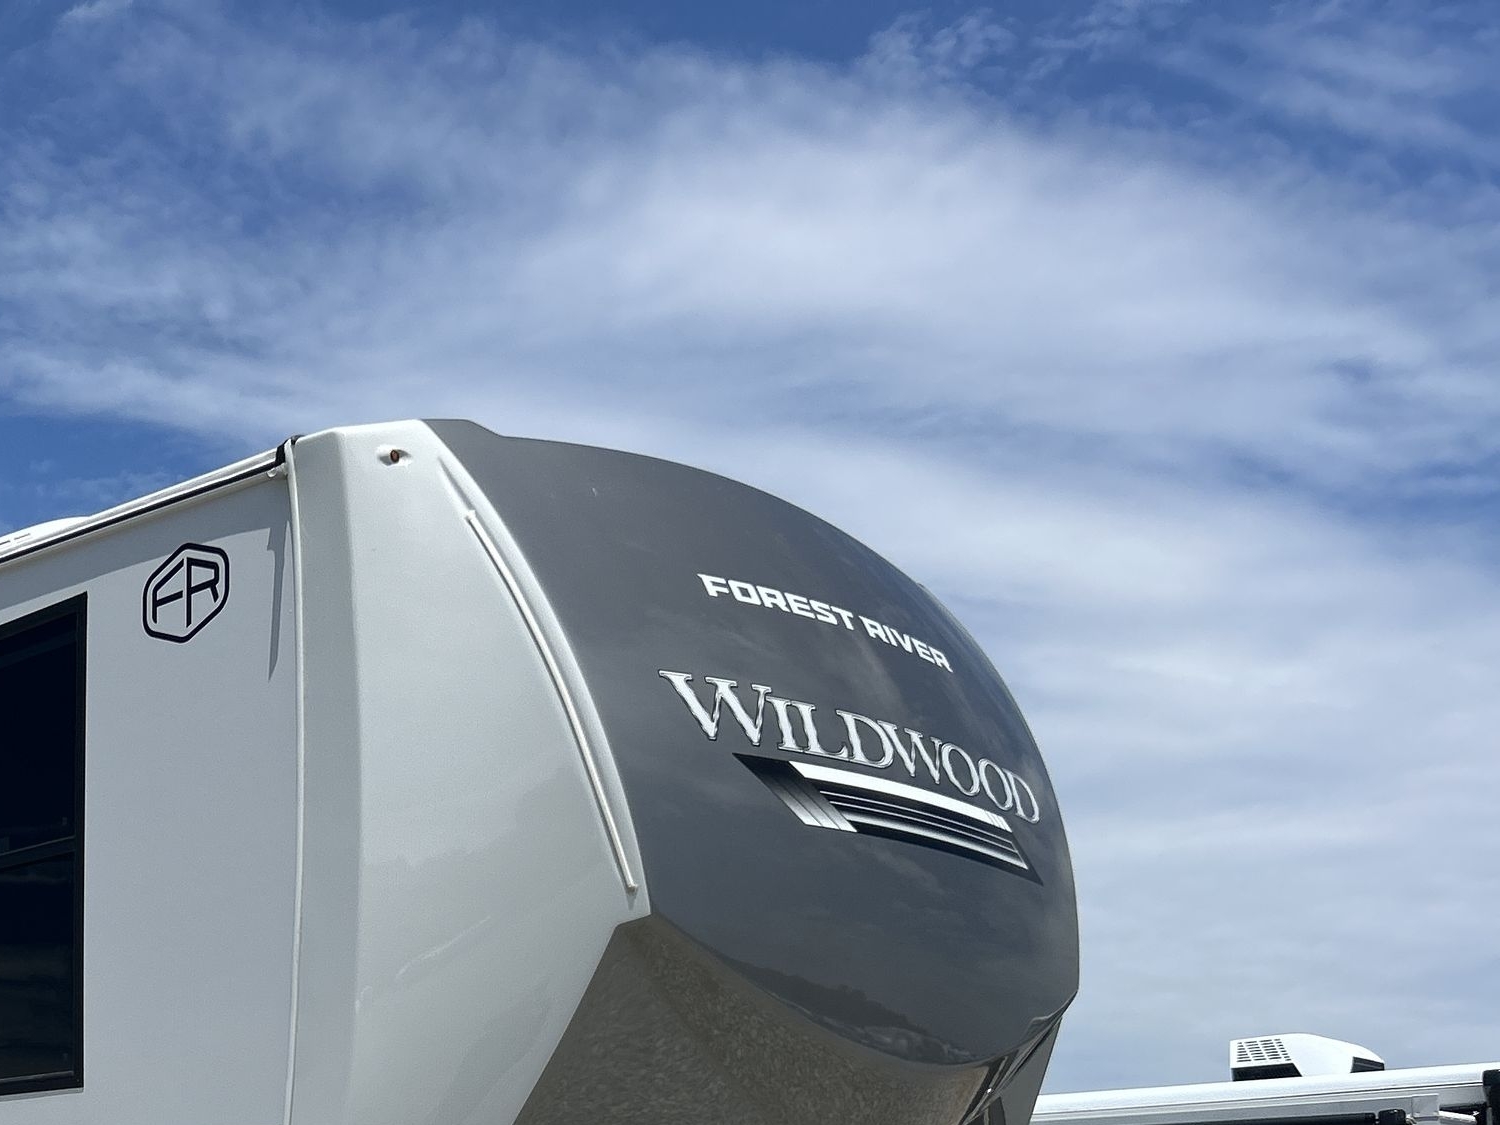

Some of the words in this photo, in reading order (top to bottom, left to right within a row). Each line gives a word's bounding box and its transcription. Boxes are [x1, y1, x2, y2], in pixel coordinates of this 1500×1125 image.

[697, 573, 857, 630] FOREST
[859, 615, 953, 672] RIVER
[659, 669, 1041, 823] WILDWOOD
